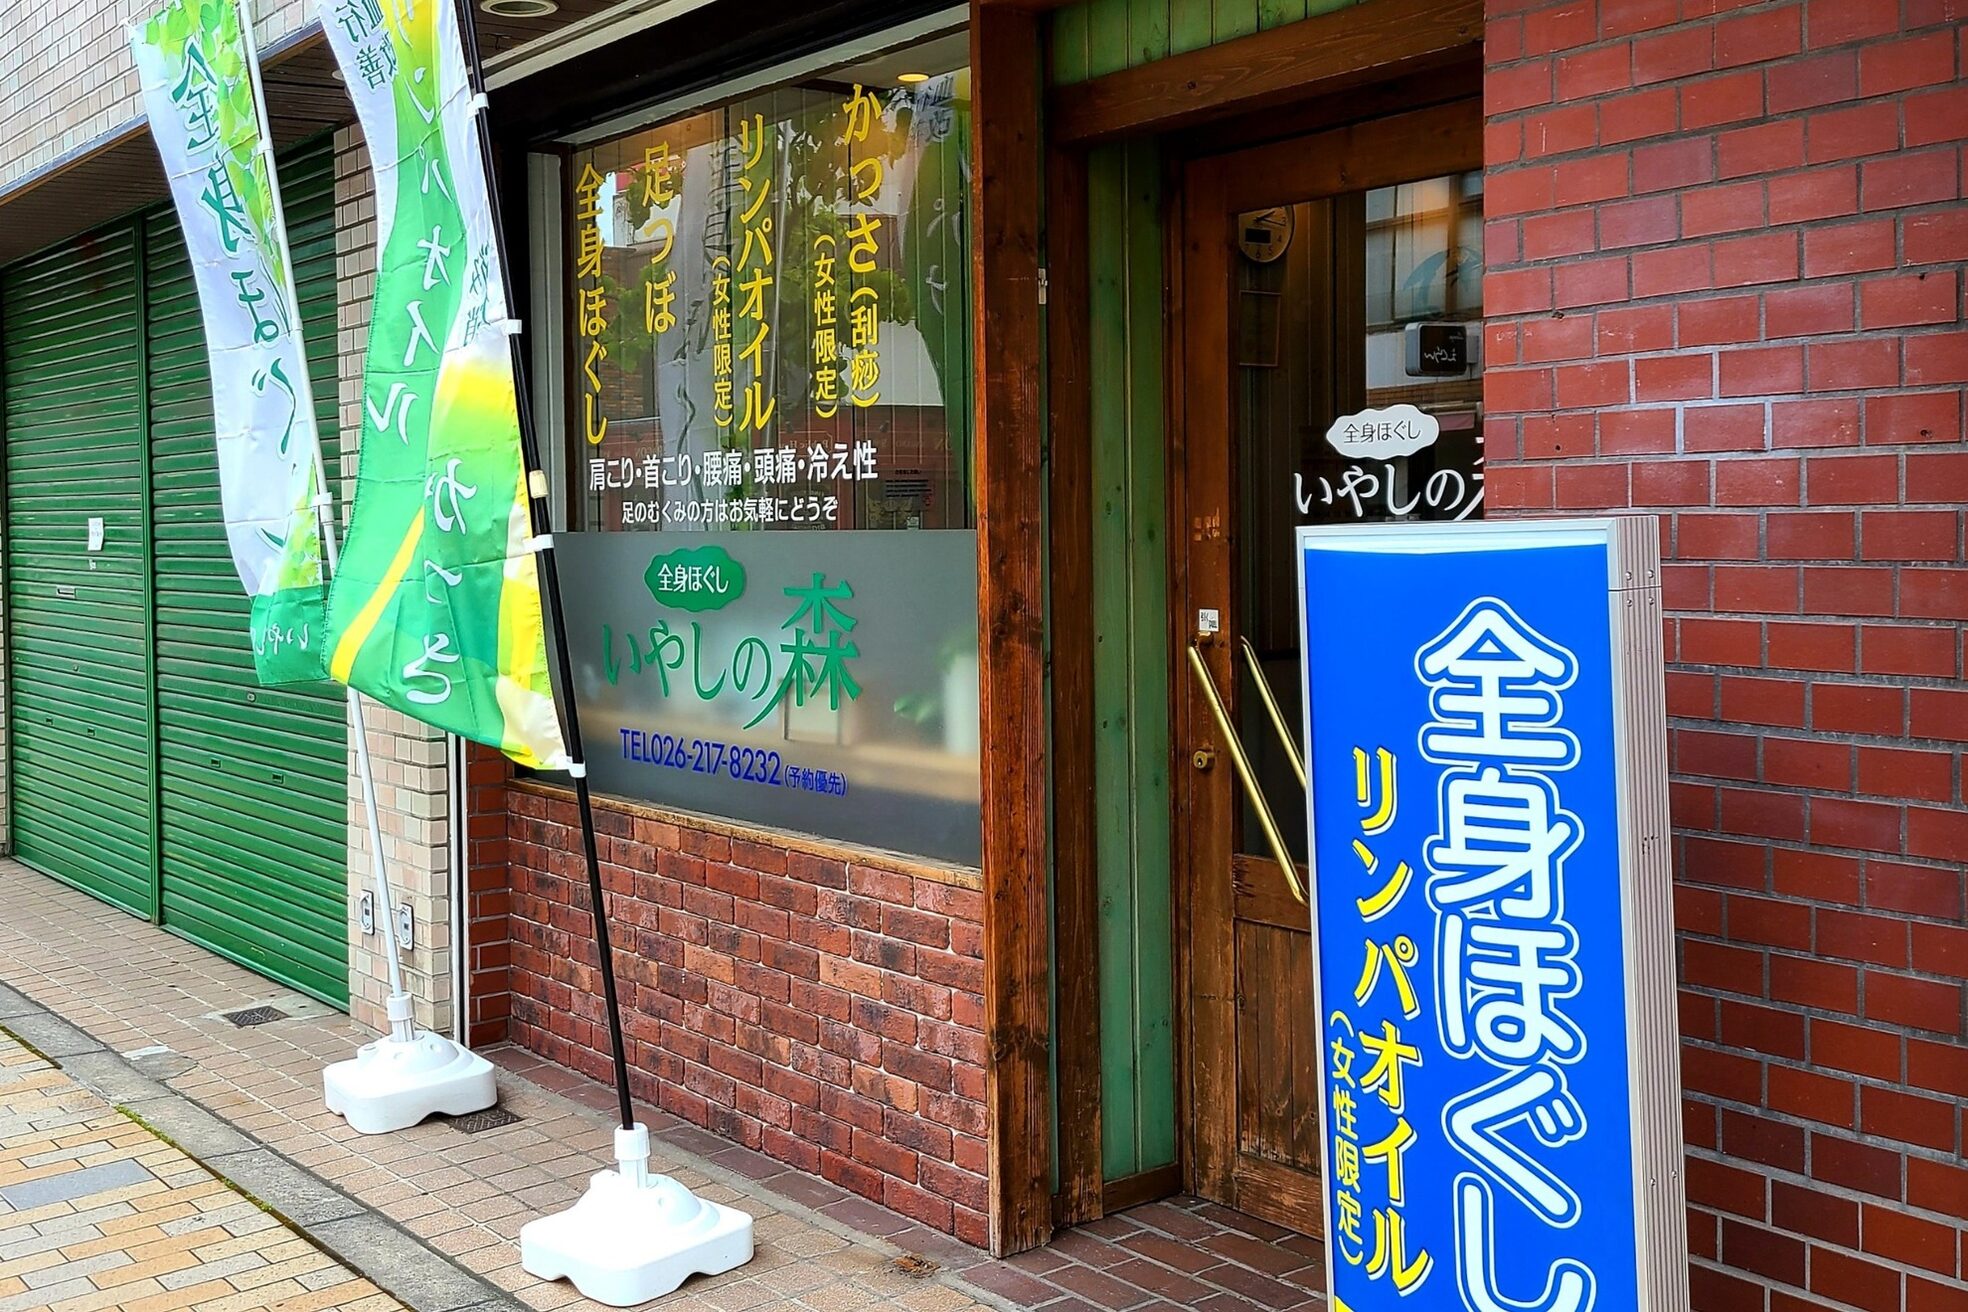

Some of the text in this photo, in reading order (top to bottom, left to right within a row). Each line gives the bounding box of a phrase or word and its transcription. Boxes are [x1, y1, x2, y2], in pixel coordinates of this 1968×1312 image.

[576, 163, 607, 445] 全身ほぐし
[642, 141, 677, 334] 足つぼ
[737, 113, 775, 431] リンパオイル
[814, 234, 837, 419] （女性限定）
[711, 255, 734, 428] （女性限定）
[1343, 419, 1422, 444] 全身ほぐし
[621, 496, 839, 525] 足のむくみの方はお気軽にどうぞ
[657, 563, 730, 594] 全身ほぐし
[603, 571, 862, 731] いやしの森
[1352, 746, 1434, 1297] リンパオイル
[1414, 596, 1597, 1312] 全身ほぐし
[1329, 1010, 1364, 1267] （女性限定）
